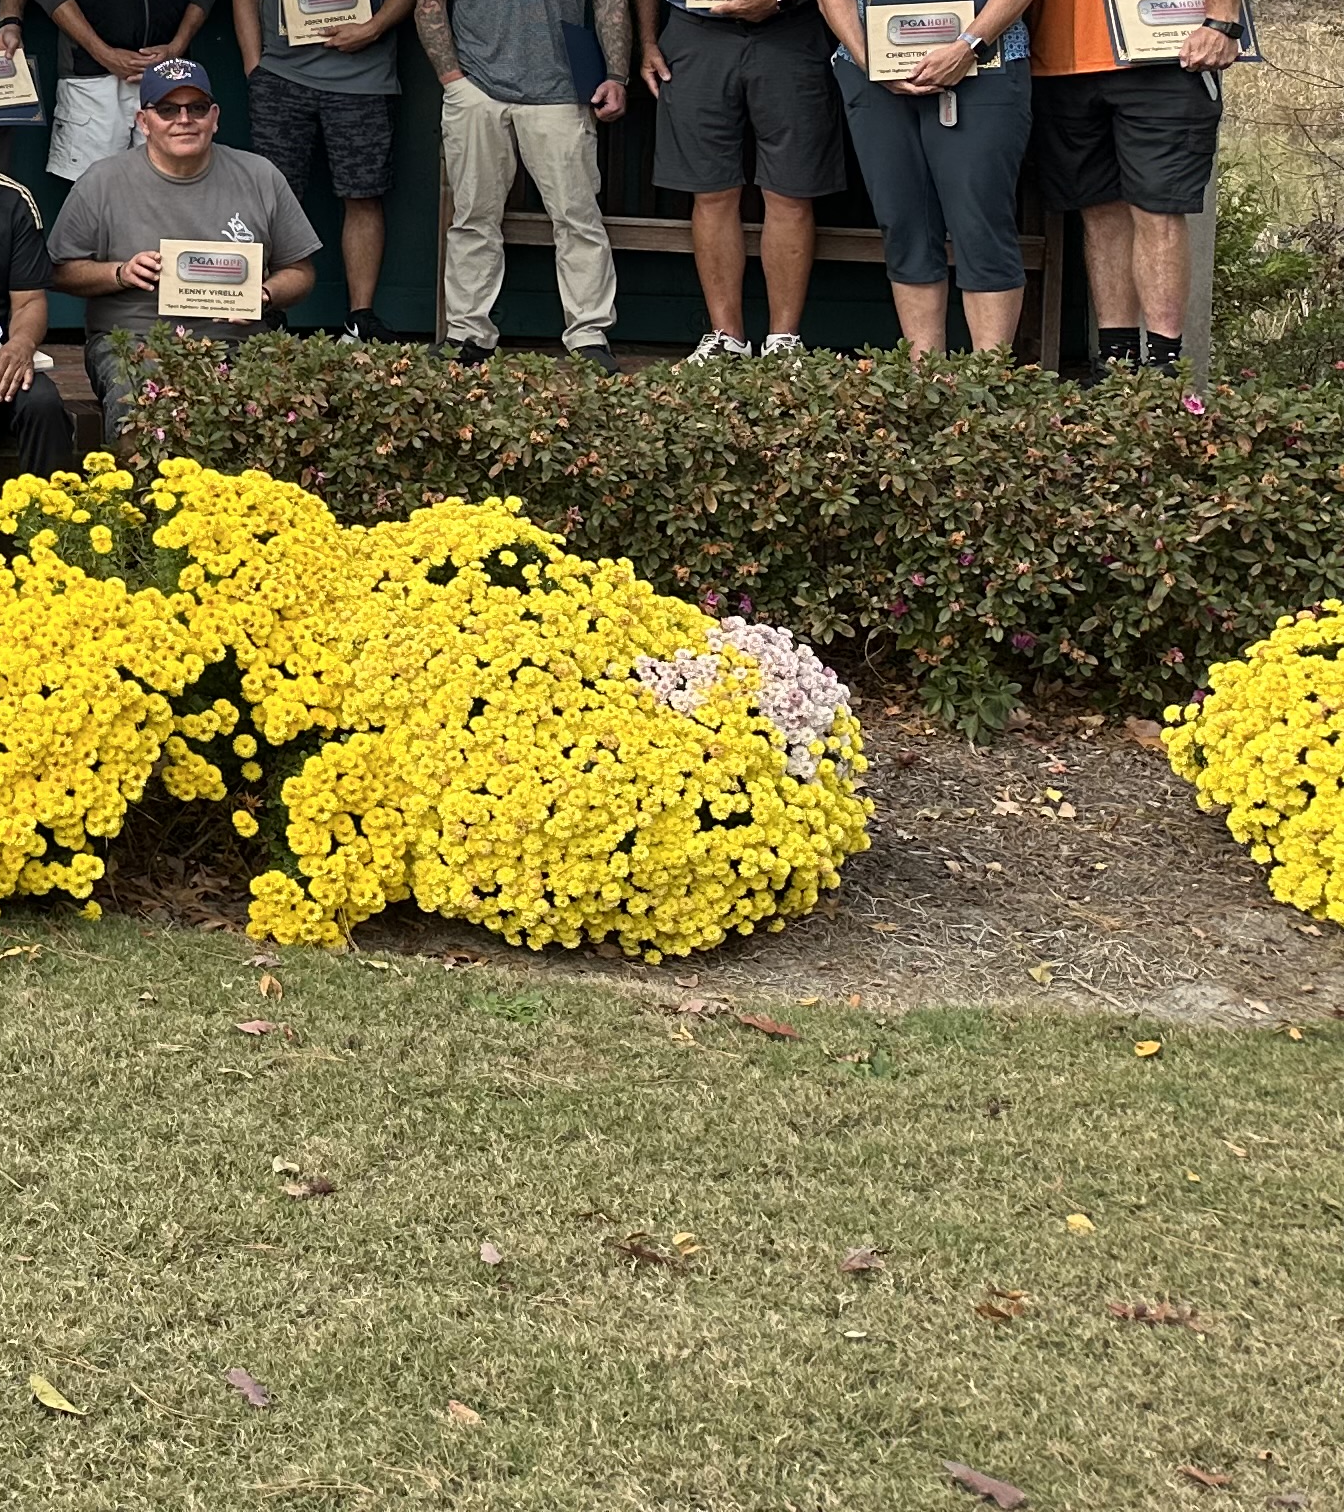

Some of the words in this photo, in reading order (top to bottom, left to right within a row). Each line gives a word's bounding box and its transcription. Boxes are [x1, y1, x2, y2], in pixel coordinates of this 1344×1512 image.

[927, 18, 955, 26] HOPE
[188, 256, 214, 265] PGA
[215, 258, 242, 266] HOPE
